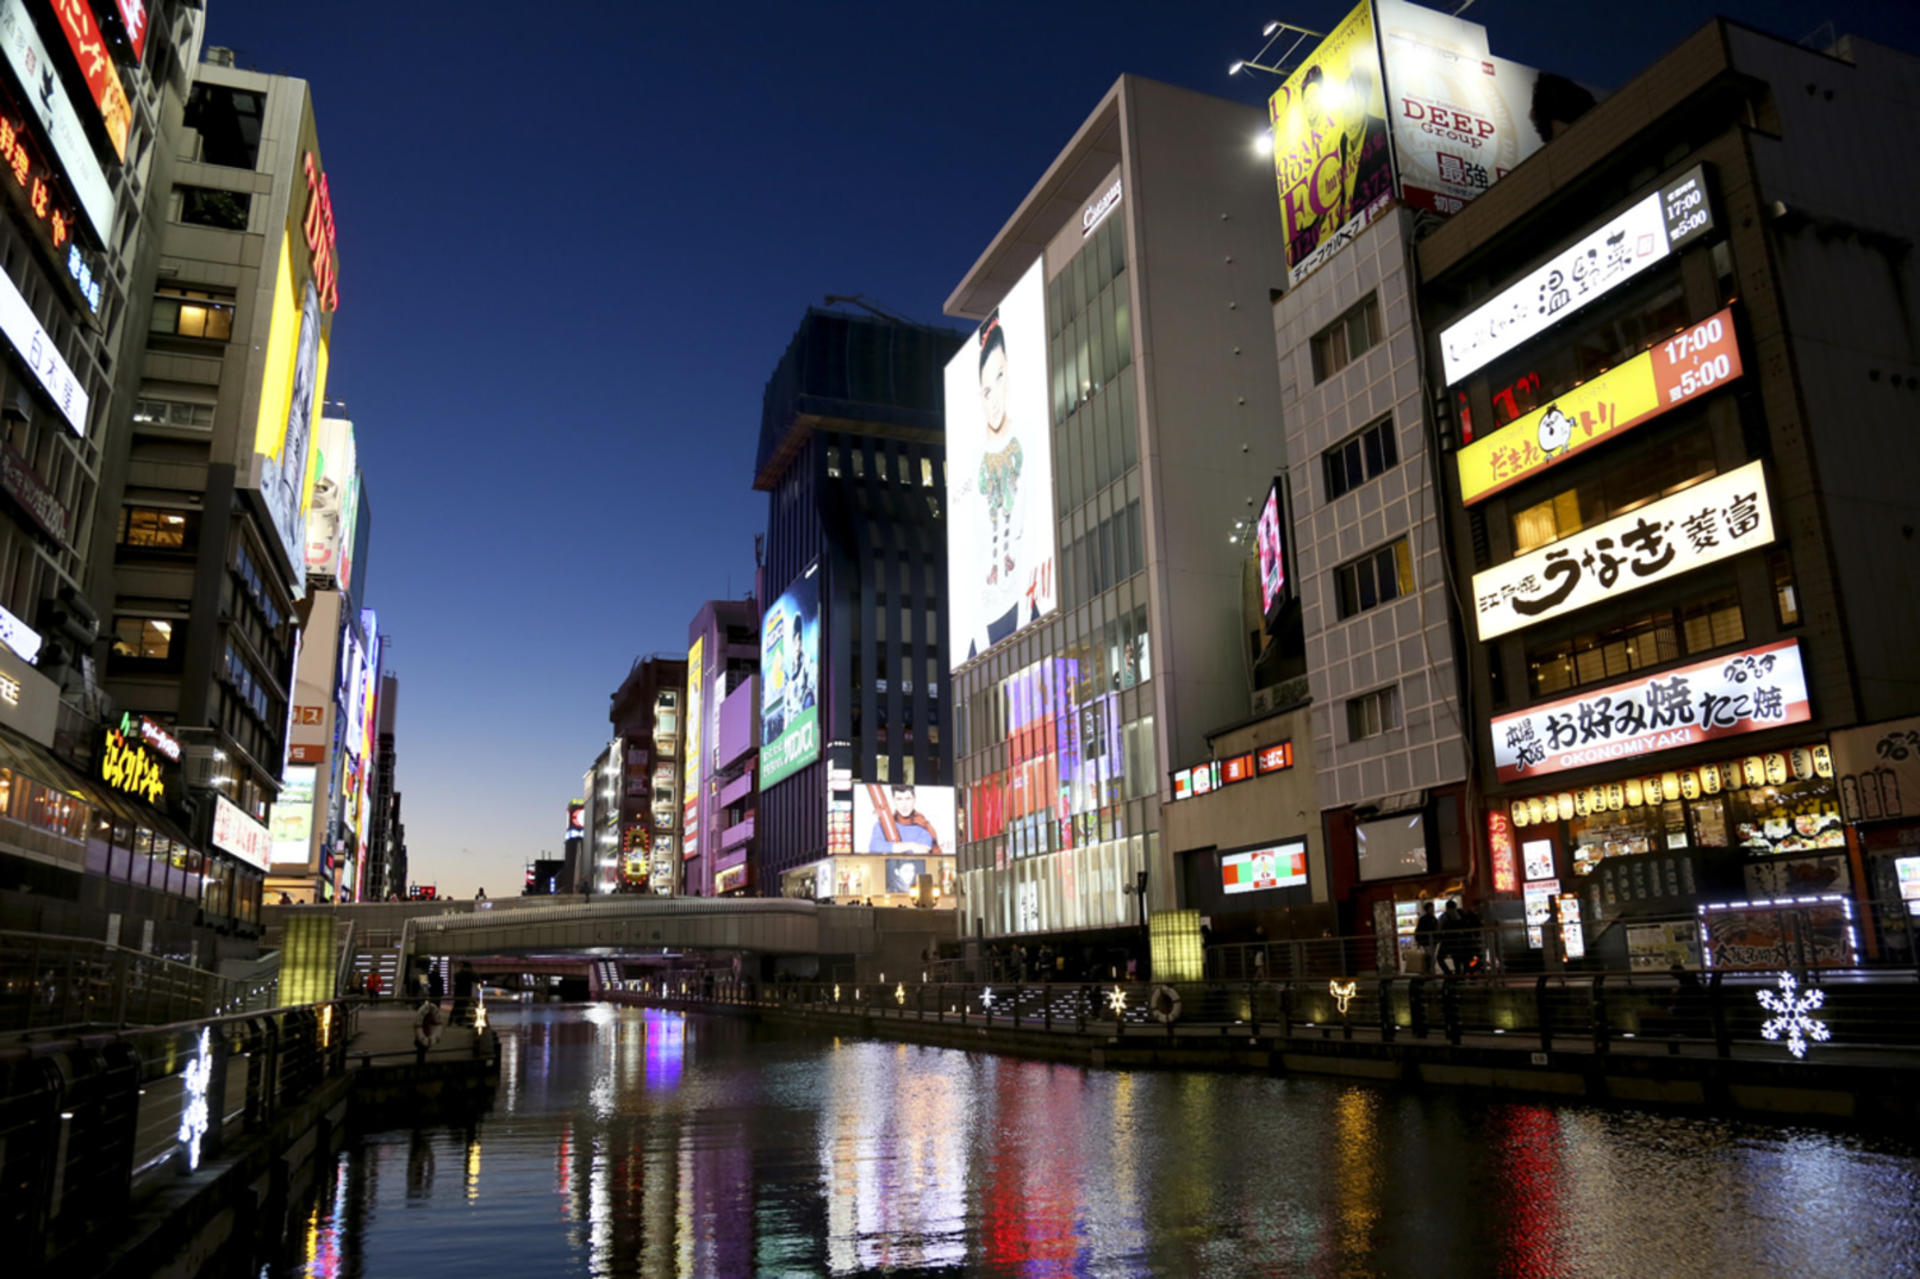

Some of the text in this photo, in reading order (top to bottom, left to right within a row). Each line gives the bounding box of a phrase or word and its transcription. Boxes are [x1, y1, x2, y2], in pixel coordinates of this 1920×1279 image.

[1401, 98, 1495, 139] DEEP
[1421, 122, 1482, 149] Group
[1440, 154, 1489, 189] 最強
[1667, 189, 1702, 220] 17:00
[1670, 209, 1707, 241] 5:00
[1664, 317, 1723, 366] 17:00
[1668, 353, 1730, 403] 5:00
[1511, 517, 1676, 617] うなぎ
[1680, 491, 1760, 554] 菱富
[1545, 675, 1783, 750] お好み焼 たこ焼
[1559, 728, 1693, 768] OKONOMIYAKI
